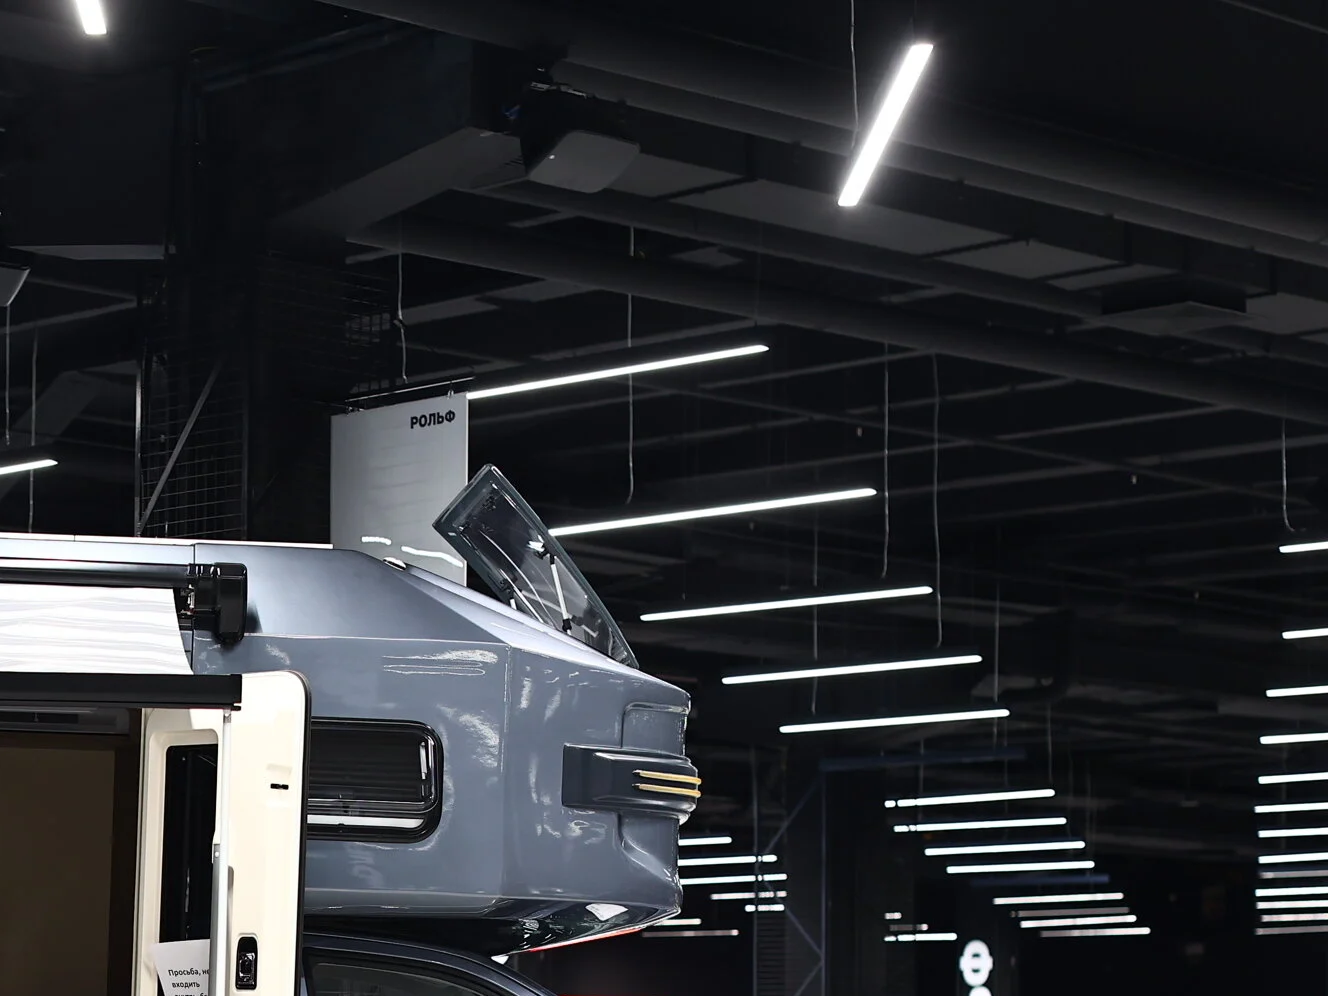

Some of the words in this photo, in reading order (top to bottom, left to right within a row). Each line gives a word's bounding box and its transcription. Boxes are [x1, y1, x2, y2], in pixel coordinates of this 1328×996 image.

[410, 409, 456, 430] РОЛЬФ
[168, 968, 202, 977] Просьба,
[172, 981, 200, 989] входить
